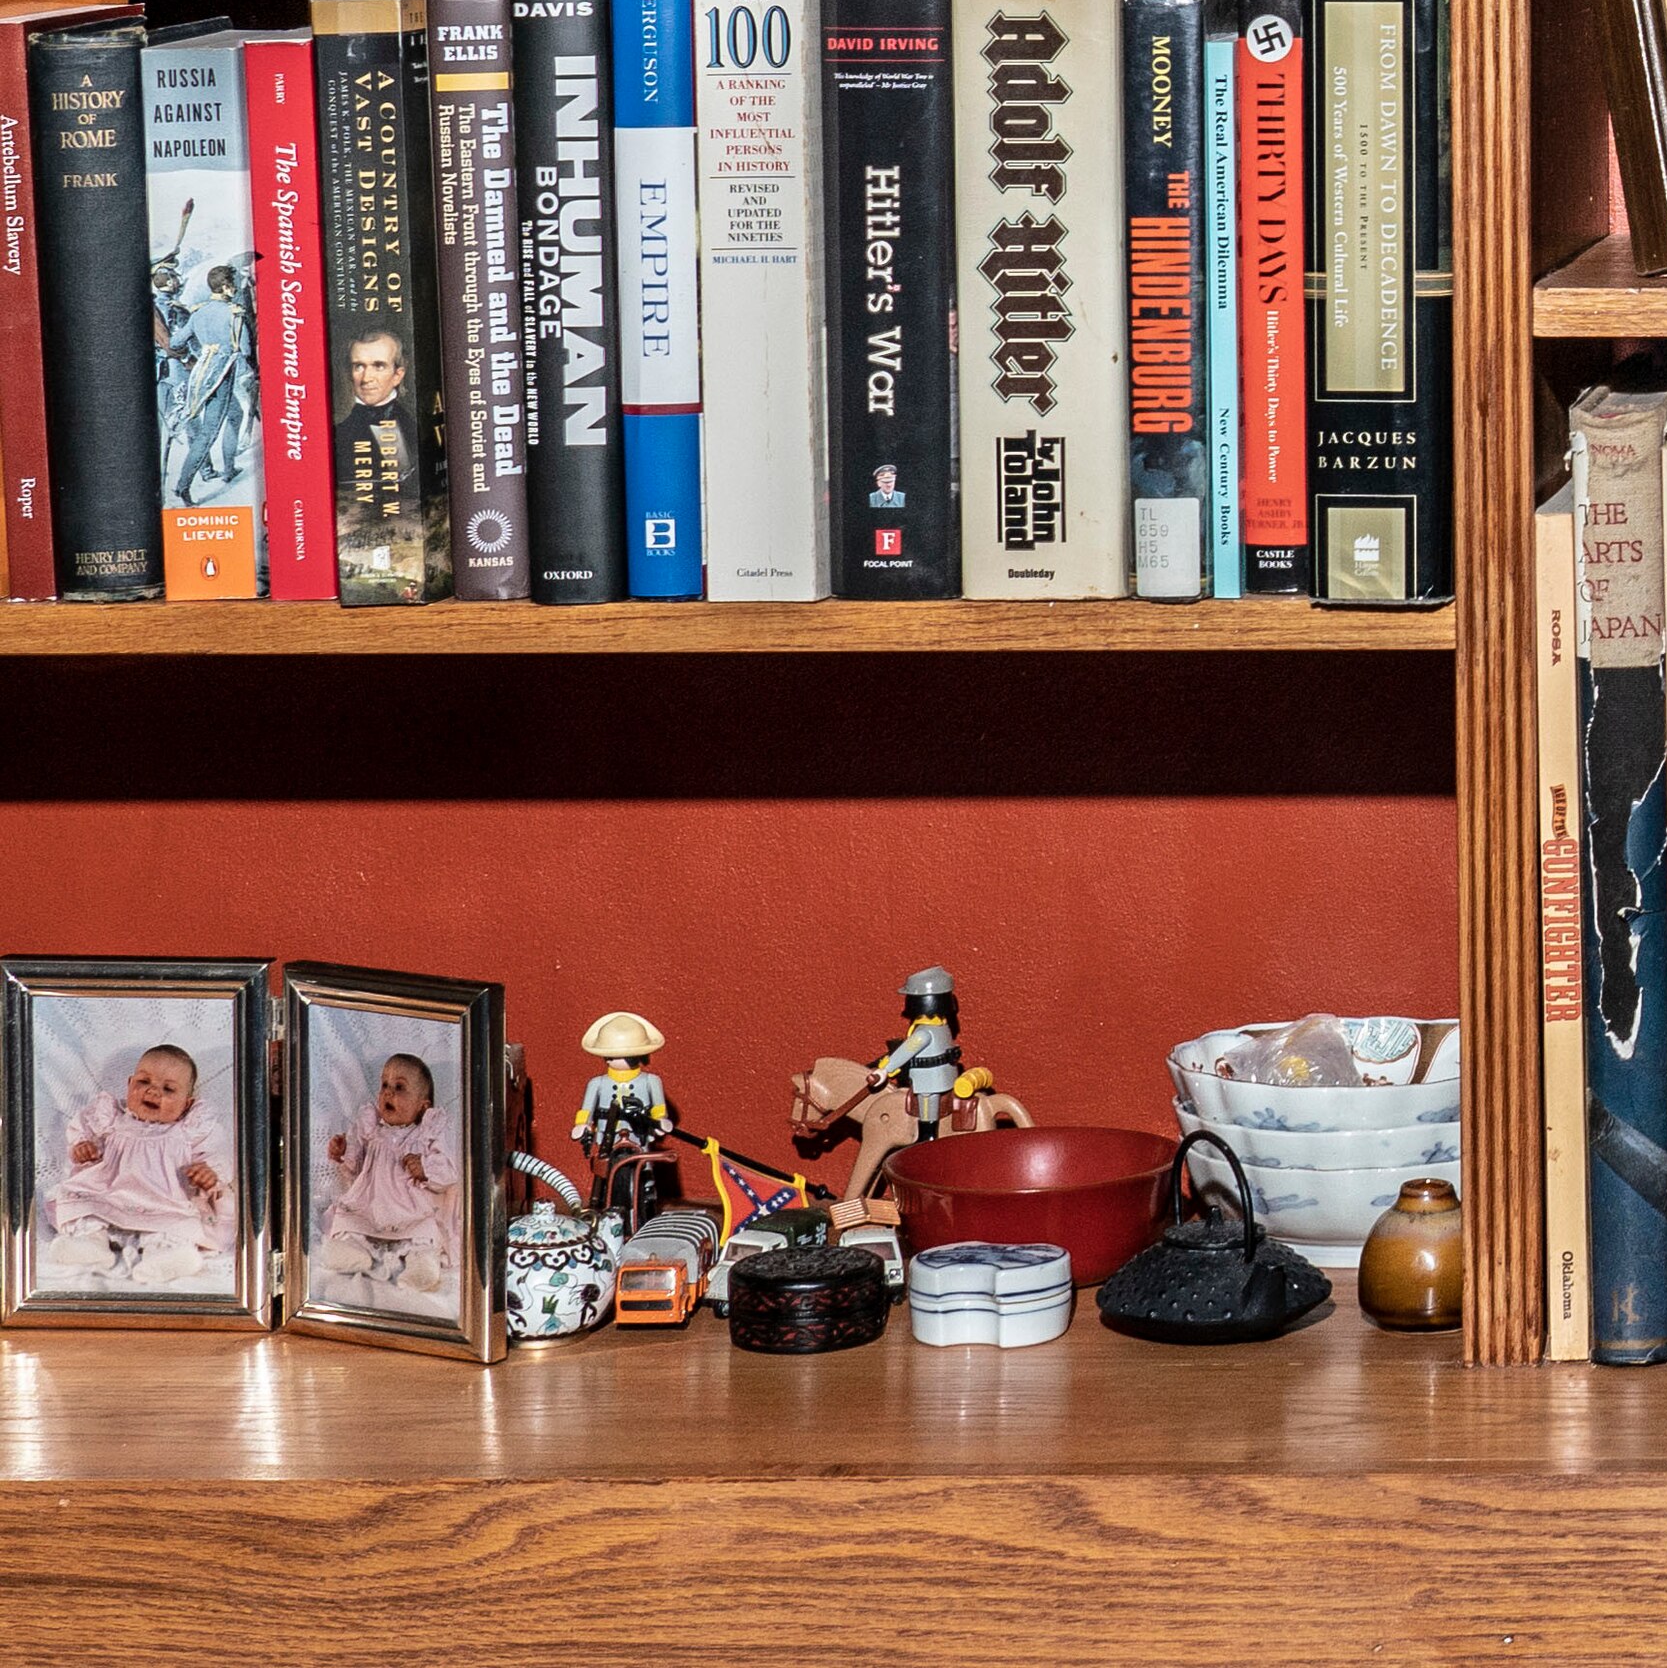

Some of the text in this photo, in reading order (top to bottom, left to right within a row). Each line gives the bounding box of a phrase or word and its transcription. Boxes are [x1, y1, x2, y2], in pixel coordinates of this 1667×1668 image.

[515, 2, 593, 17] DAVIS
[705, 6, 791, 68] 100
[828, 38, 938, 50] DAVID IRVING
[80, 75, 92, 87] A
[158, 68, 216, 87] RUSSIA
[53, 91, 124, 109] HISTORY
[1152, 36, 1171, 147] MOONEY
[78, 114, 96, 124] OF
[154, 103, 221, 123] AGAINST
[61, 130, 116, 148] ROME
[154, 139, 225, 157] NAPOLEON
[64, 173, 117, 187] FRANK
[1257, 74, 1286, 303] THIRTY DAYS
[1167, 171, 1190, 209] THE
[977, 10, 1076, 417] Adolf Hitler
[535, 165, 562, 340] BONDAGE
[554, 56, 606, 445] INHUMAN
[640, 177, 670, 360] EMPIRE
[482, 103, 521, 477] The Damned and the Dead
[866, 166, 901, 416] Hitler's War
[272, 143, 307, 460] The Spanish Seaborne Empire
[1128, 218, 1192, 432] HINDENBURG
[1318, 432, 1416, 446] JACQUES
[1319, 456, 1416, 469] BARZUN
[1003, 429, 1036, 551] Toland
[1032, 459, 1061, 543] John
[177, 516, 238, 526] DOMINIC
[183, 530, 233, 541] LIEVEN
[544, 571, 592, 579] OXFORD
[1008, 569, 1055, 580] Doubleday
